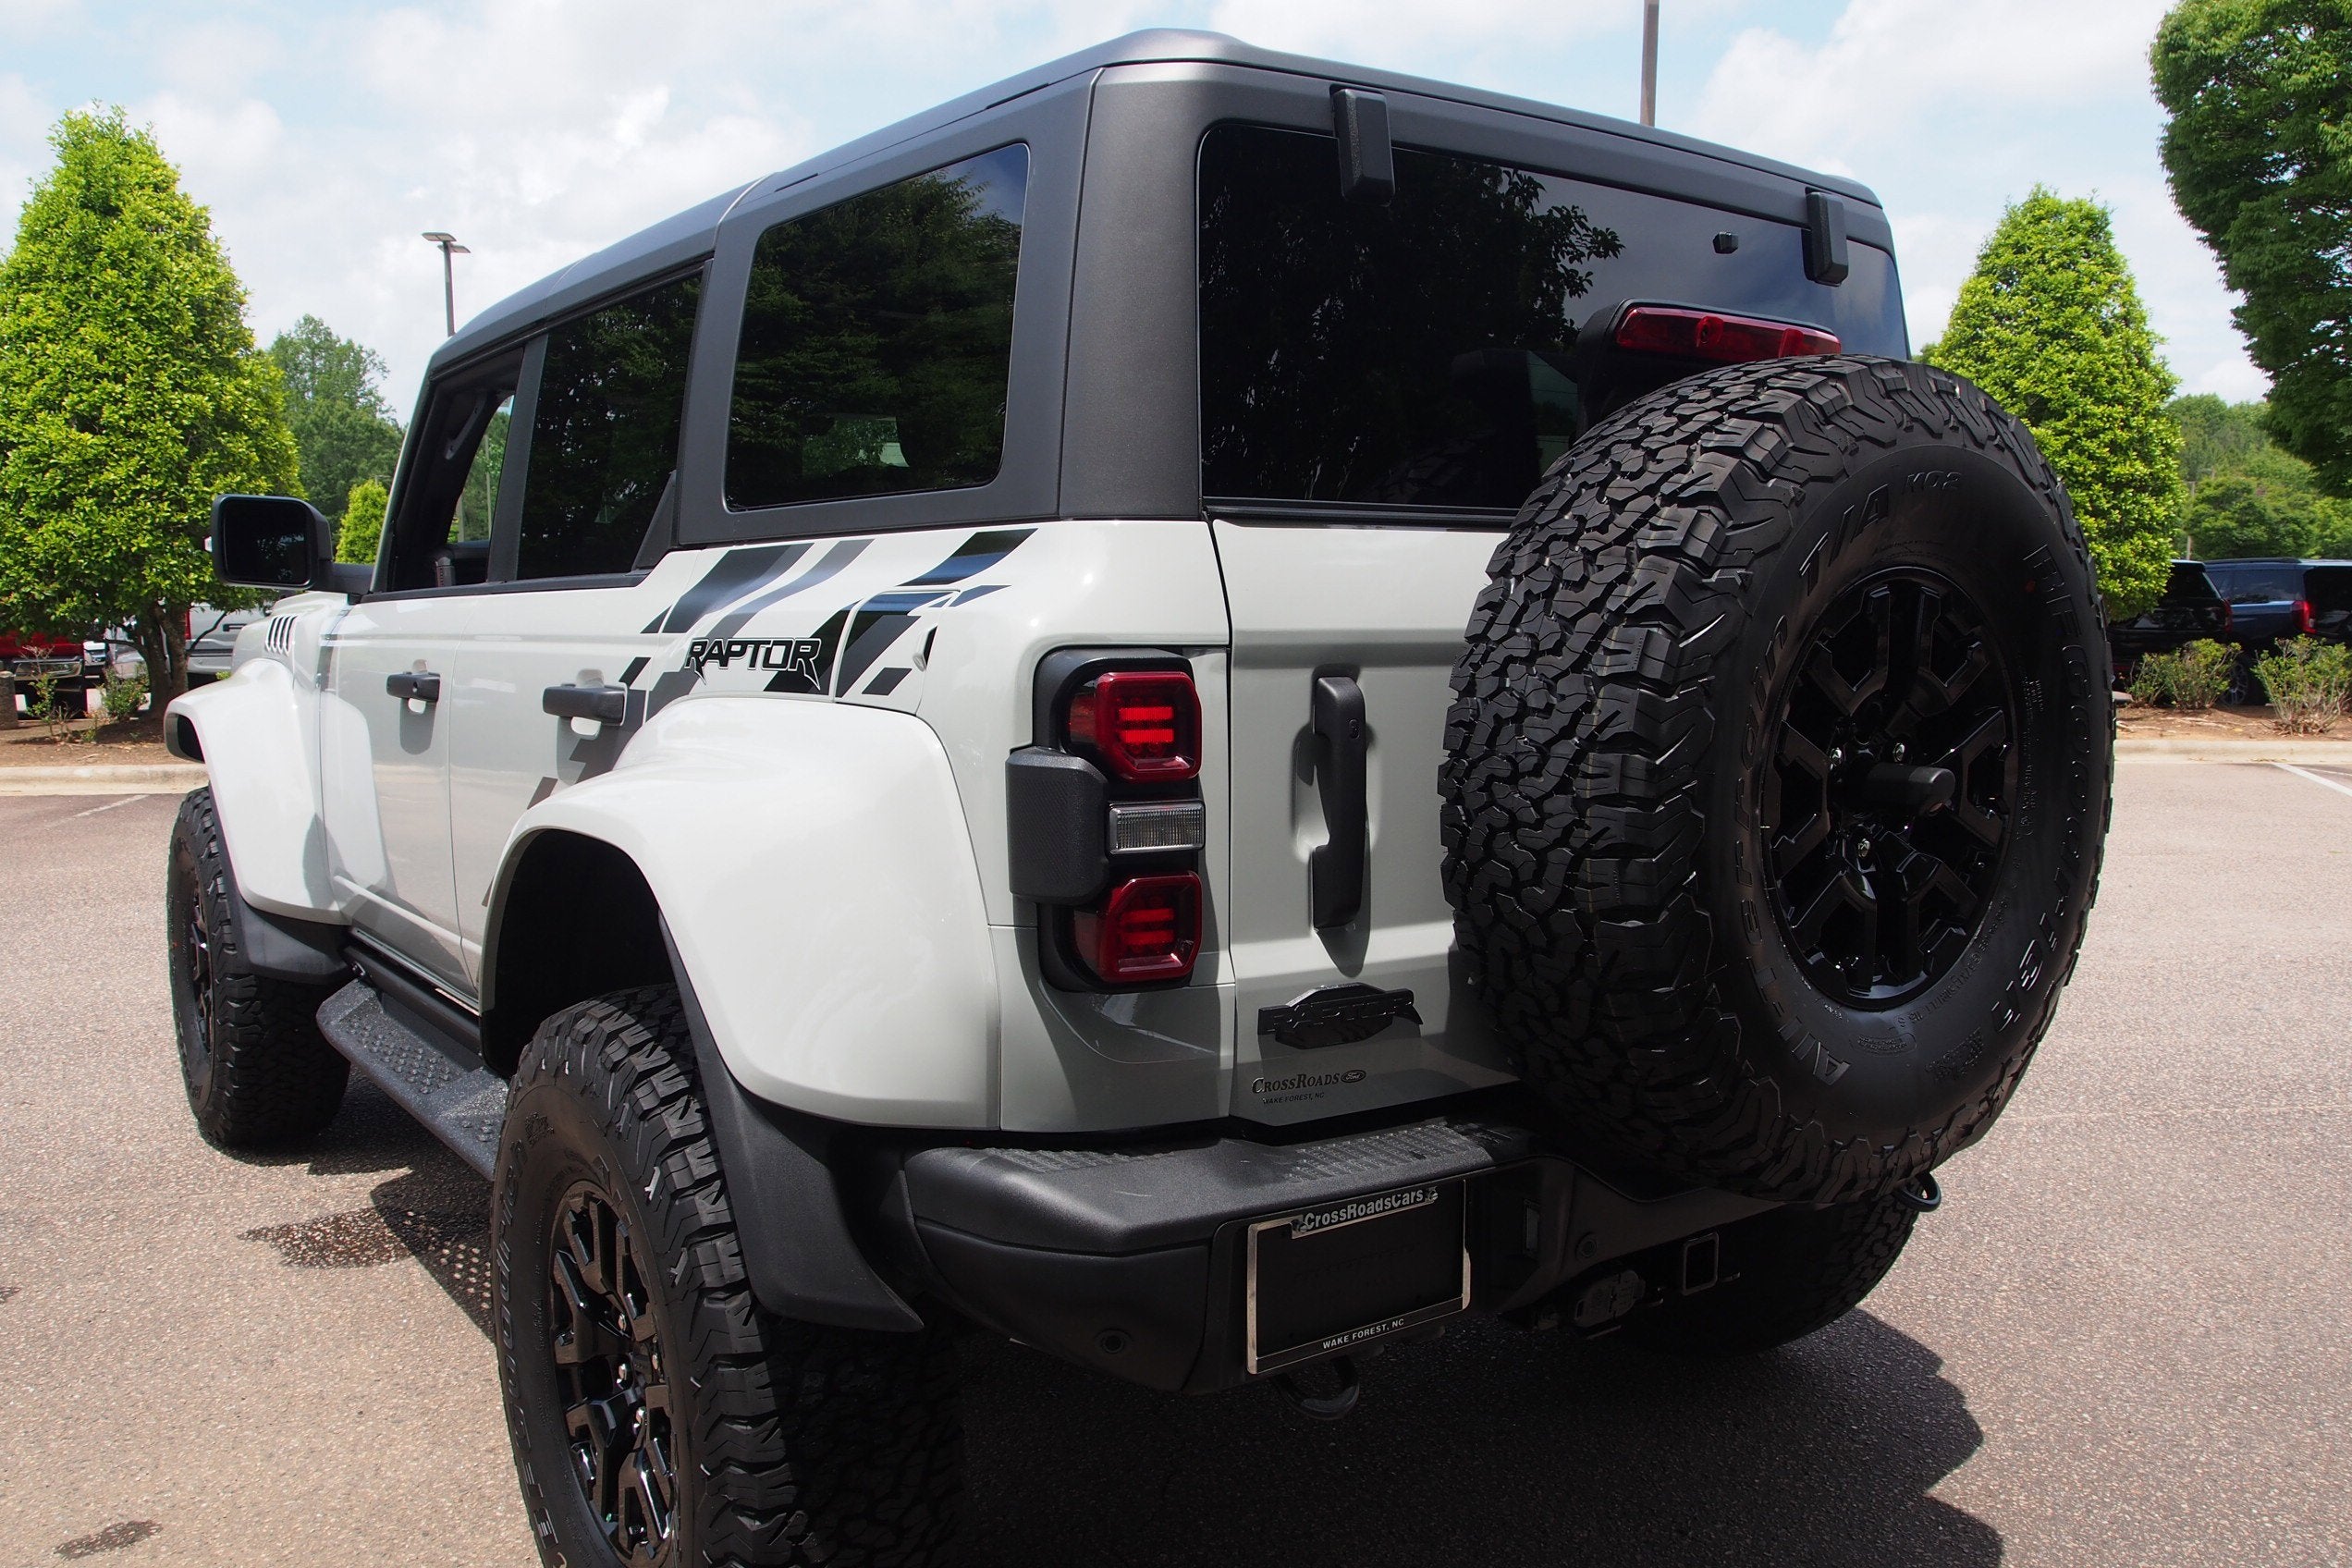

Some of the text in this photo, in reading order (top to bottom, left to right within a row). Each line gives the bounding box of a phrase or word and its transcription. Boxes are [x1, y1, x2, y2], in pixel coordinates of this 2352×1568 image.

[1798, 483, 1891, 596] T/A
[1902, 470, 1962, 495] KO2
[684, 637, 821, 692] RAPTOR
[1262, 1091, 1325, 1105] WAKE FOREST, NC
[1304, 1188, 1424, 1231] CrossRoadsCars
[1322, 1317, 1404, 1350] WAKE FOREST, NC
